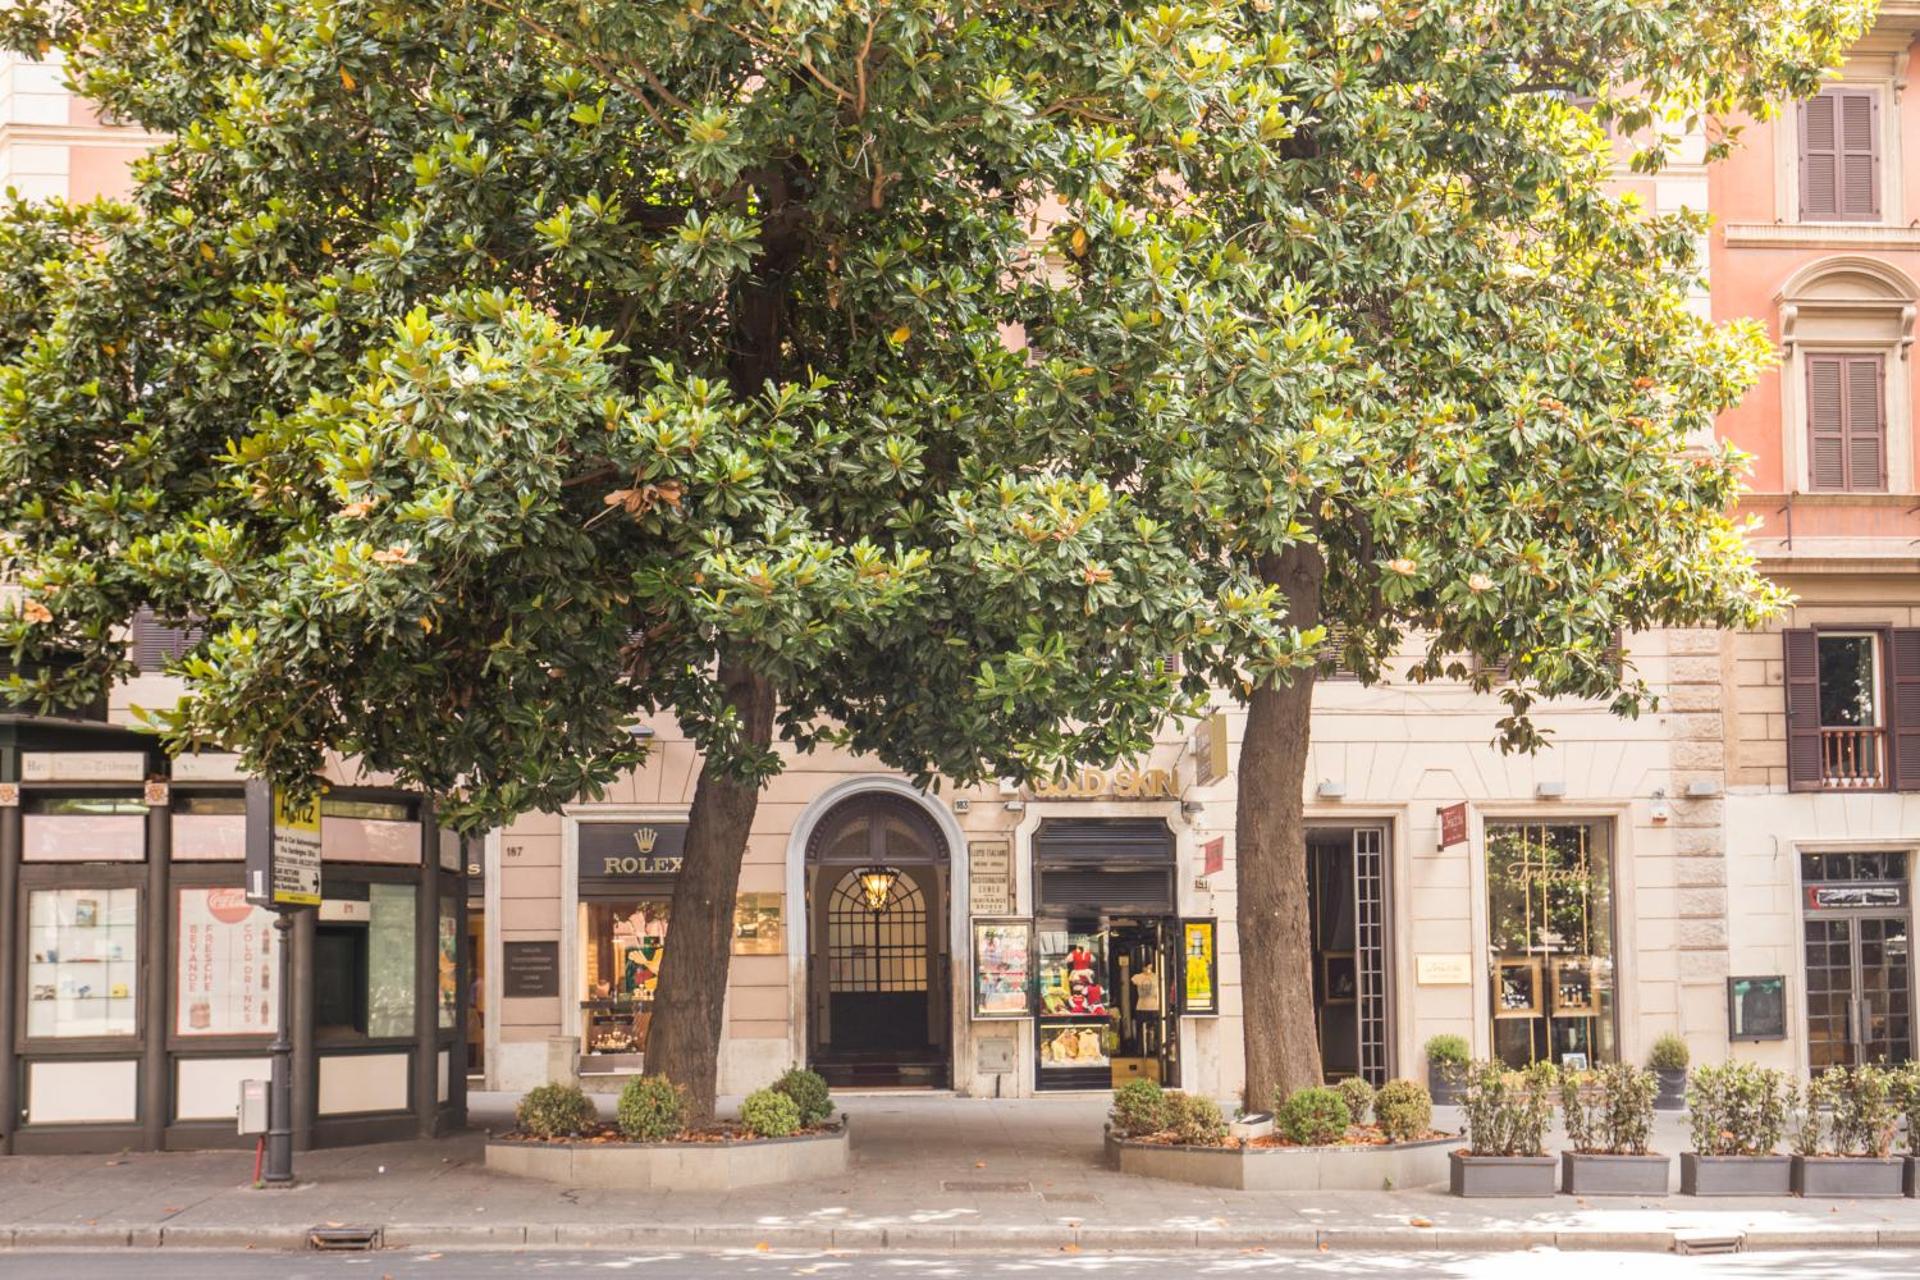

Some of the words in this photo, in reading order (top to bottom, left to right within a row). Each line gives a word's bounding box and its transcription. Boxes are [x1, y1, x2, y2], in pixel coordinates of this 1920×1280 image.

[1035, 769, 1106, 797] GOLD
[1114, 769, 1180, 797] SKIN
[280, 795, 315, 824] Hrtz
[604, 857, 683, 874] ROLEX
[243, 924, 254, 961] COLD
[188, 924, 198, 993] BEVANDE
